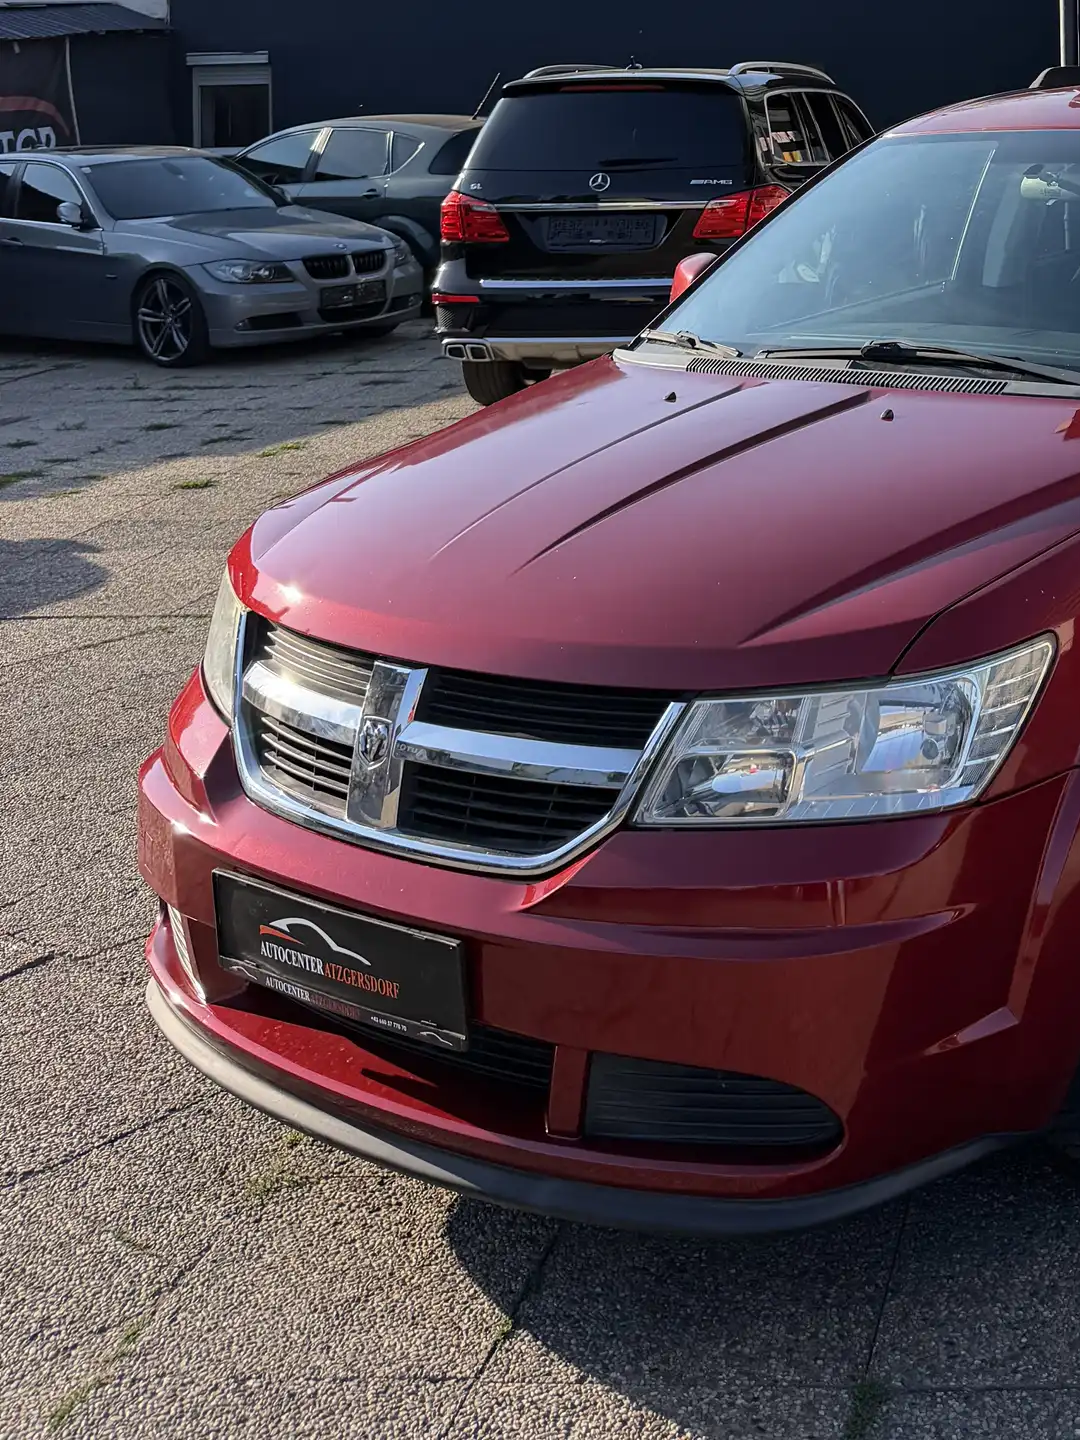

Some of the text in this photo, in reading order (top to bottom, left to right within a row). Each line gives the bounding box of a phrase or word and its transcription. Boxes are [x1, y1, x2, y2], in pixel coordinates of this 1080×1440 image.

[260, 940, 400, 999] AUTOCENTER ATZGERSDORF
[265, 976, 310, 1002] AUTOCENTER
